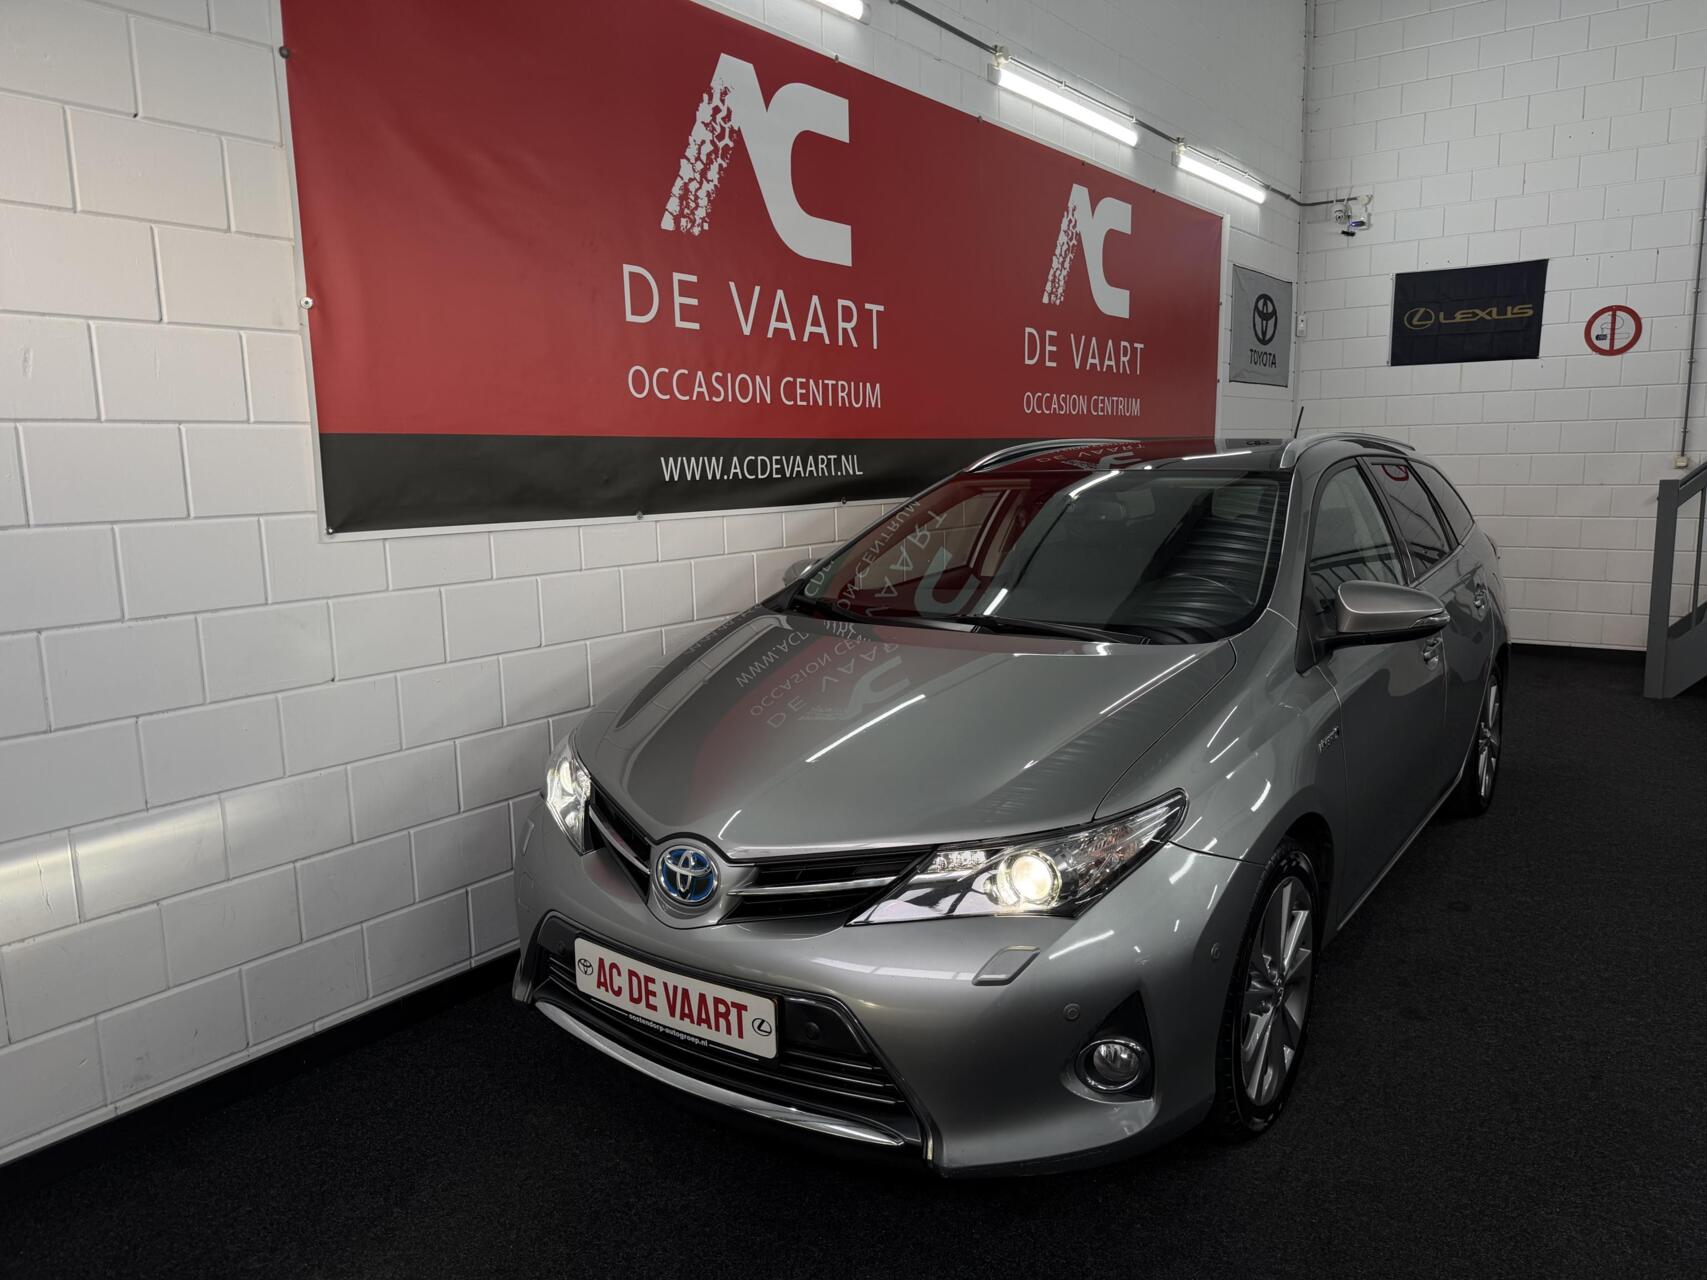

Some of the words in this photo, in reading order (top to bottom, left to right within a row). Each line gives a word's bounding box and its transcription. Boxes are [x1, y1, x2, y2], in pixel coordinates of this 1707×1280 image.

[660, 53, 852, 267] AC
[1042, 183, 1132, 319] AC
[622, 263, 701, 330] DE
[729, 281, 885, 350] VAART
[1438, 304, 1534, 323] LEXUS
[1023, 327, 1057, 367] DE
[1070, 333, 1145, 376] VAART
[1249, 348, 1277, 368] TOYOTA
[627, 365, 771, 405] OCCASION
[779, 376, 882, 409] CENTRUM
[1023, 392, 1086, 415] OCCASION
[1090, 395, 1141, 417] CENTRUM
[660, 454, 863, 482] WWW.ACDEVAART.NL
[596, 957, 622, 998] AC
[627, 968, 658, 1013] DE
[662, 981, 749, 1040] VAART
